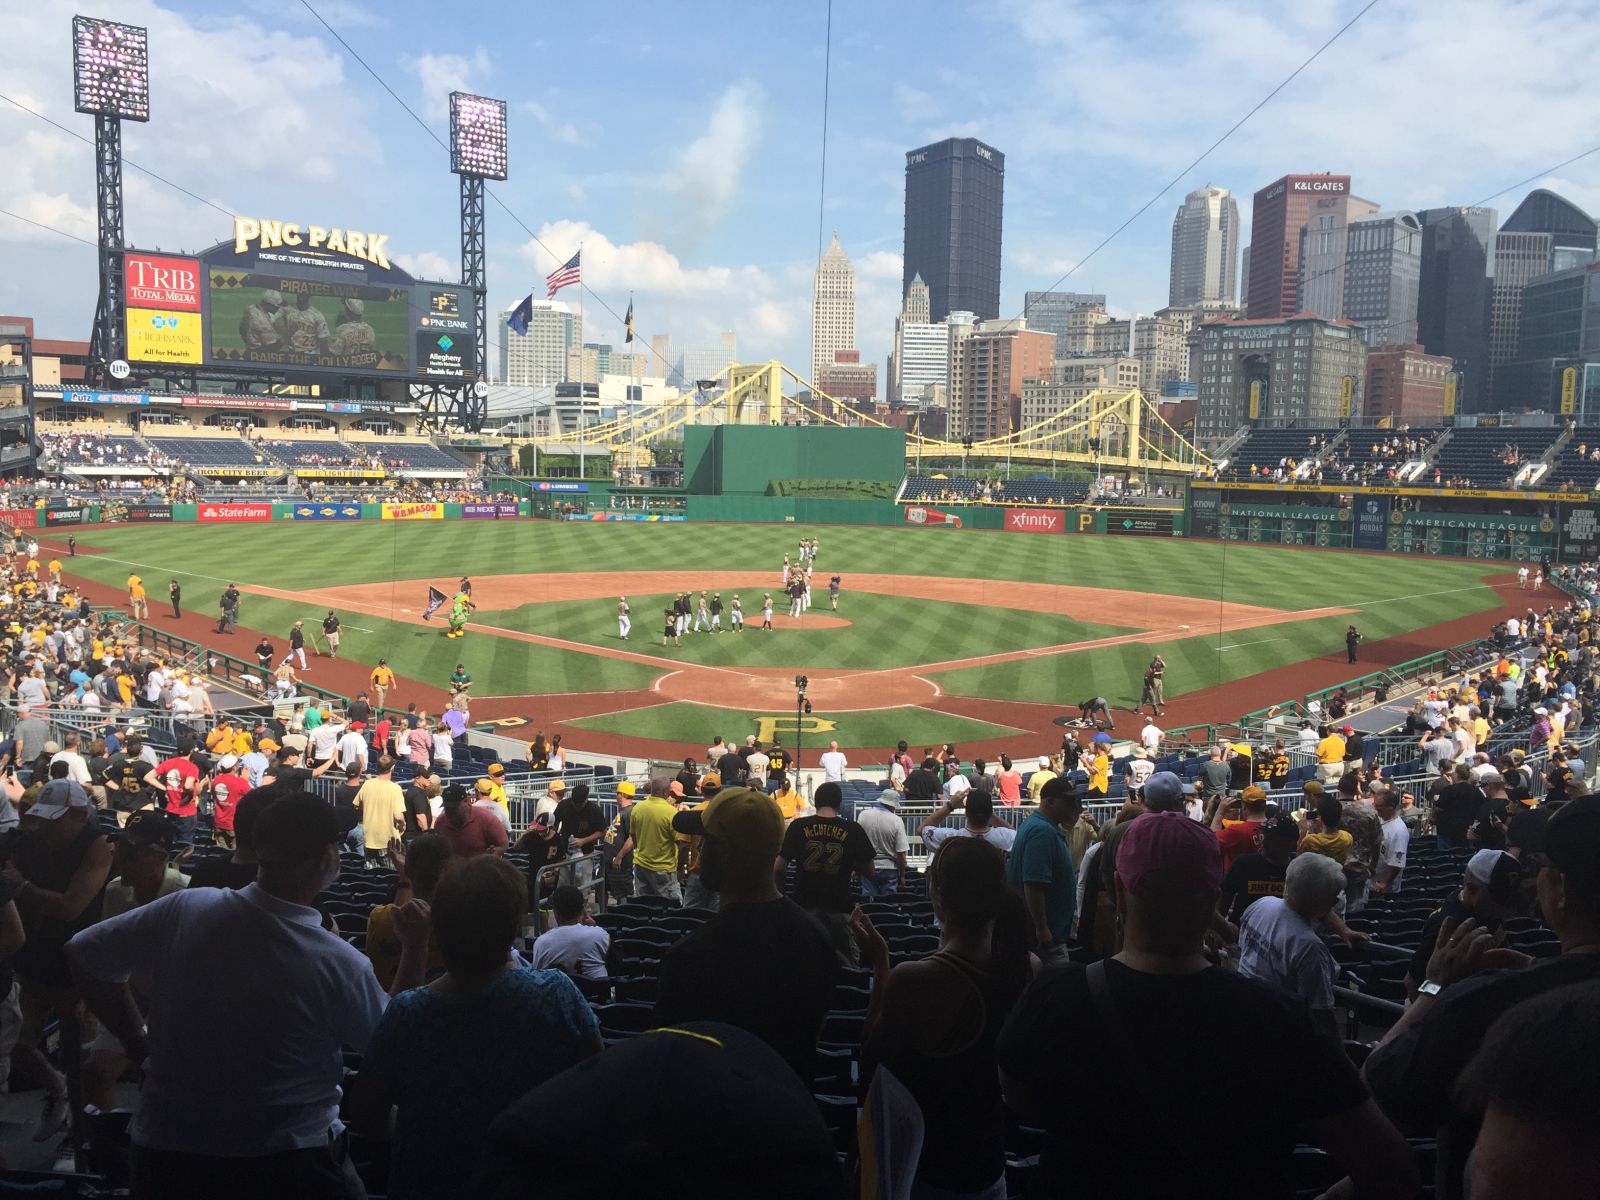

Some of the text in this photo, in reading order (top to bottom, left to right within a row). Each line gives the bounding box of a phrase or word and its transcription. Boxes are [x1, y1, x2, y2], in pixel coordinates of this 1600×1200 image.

[975, 145, 992, 161] UPMC
[1294, 182, 1344, 191] K&L GATES
[235, 215, 391, 270] PNC PARK
[258, 253, 365, 271] HOME OF THE PITTSBURGH PIRATES
[129, 260, 195, 291] TRIB
[280, 279, 359, 298] PIRATES WIN
[131, 287, 196, 303] TOTAL MEDIA
[430, 318, 468, 329] PNC BANK
[144, 330, 195, 344] HIGHMARK
[144, 348, 154, 356] All
[167, 349, 190, 358] Health
[429, 353, 461, 363] Allegheny
[250, 351, 377, 367] RAISE THE JOLLY ROGER
[112, 363, 128, 374] Lite
[198, 398, 226, 406] KNOCKING
[226, 399, 247, 407] SAVINGS
[245, 469, 269, 477] BEER
[1232, 510, 1336, 521] NATIONAL LEAGUE
[1360, 514, 1384, 523] BORDAS
[1572, 509, 1595, 518] EVERY
[1012, 513, 1057, 529] xfinity
[1079, 513, 1093, 531] P
[1406, 519, 1477, 529] AMERICAN
[1481, 521, 1537, 533] LEAGUE
[1569, 516, 1598, 525] SEASON
[1359, 523, 1384, 532] BORDAS
[1563, 523, 1591, 533] STARTS
[754, 764, 766, 774] 21
[770, 758, 783, 769] 45
[121, 777, 141, 793] 45
[805, 841, 844, 872] 22
[1250, 883, 1268, 892] JUST
